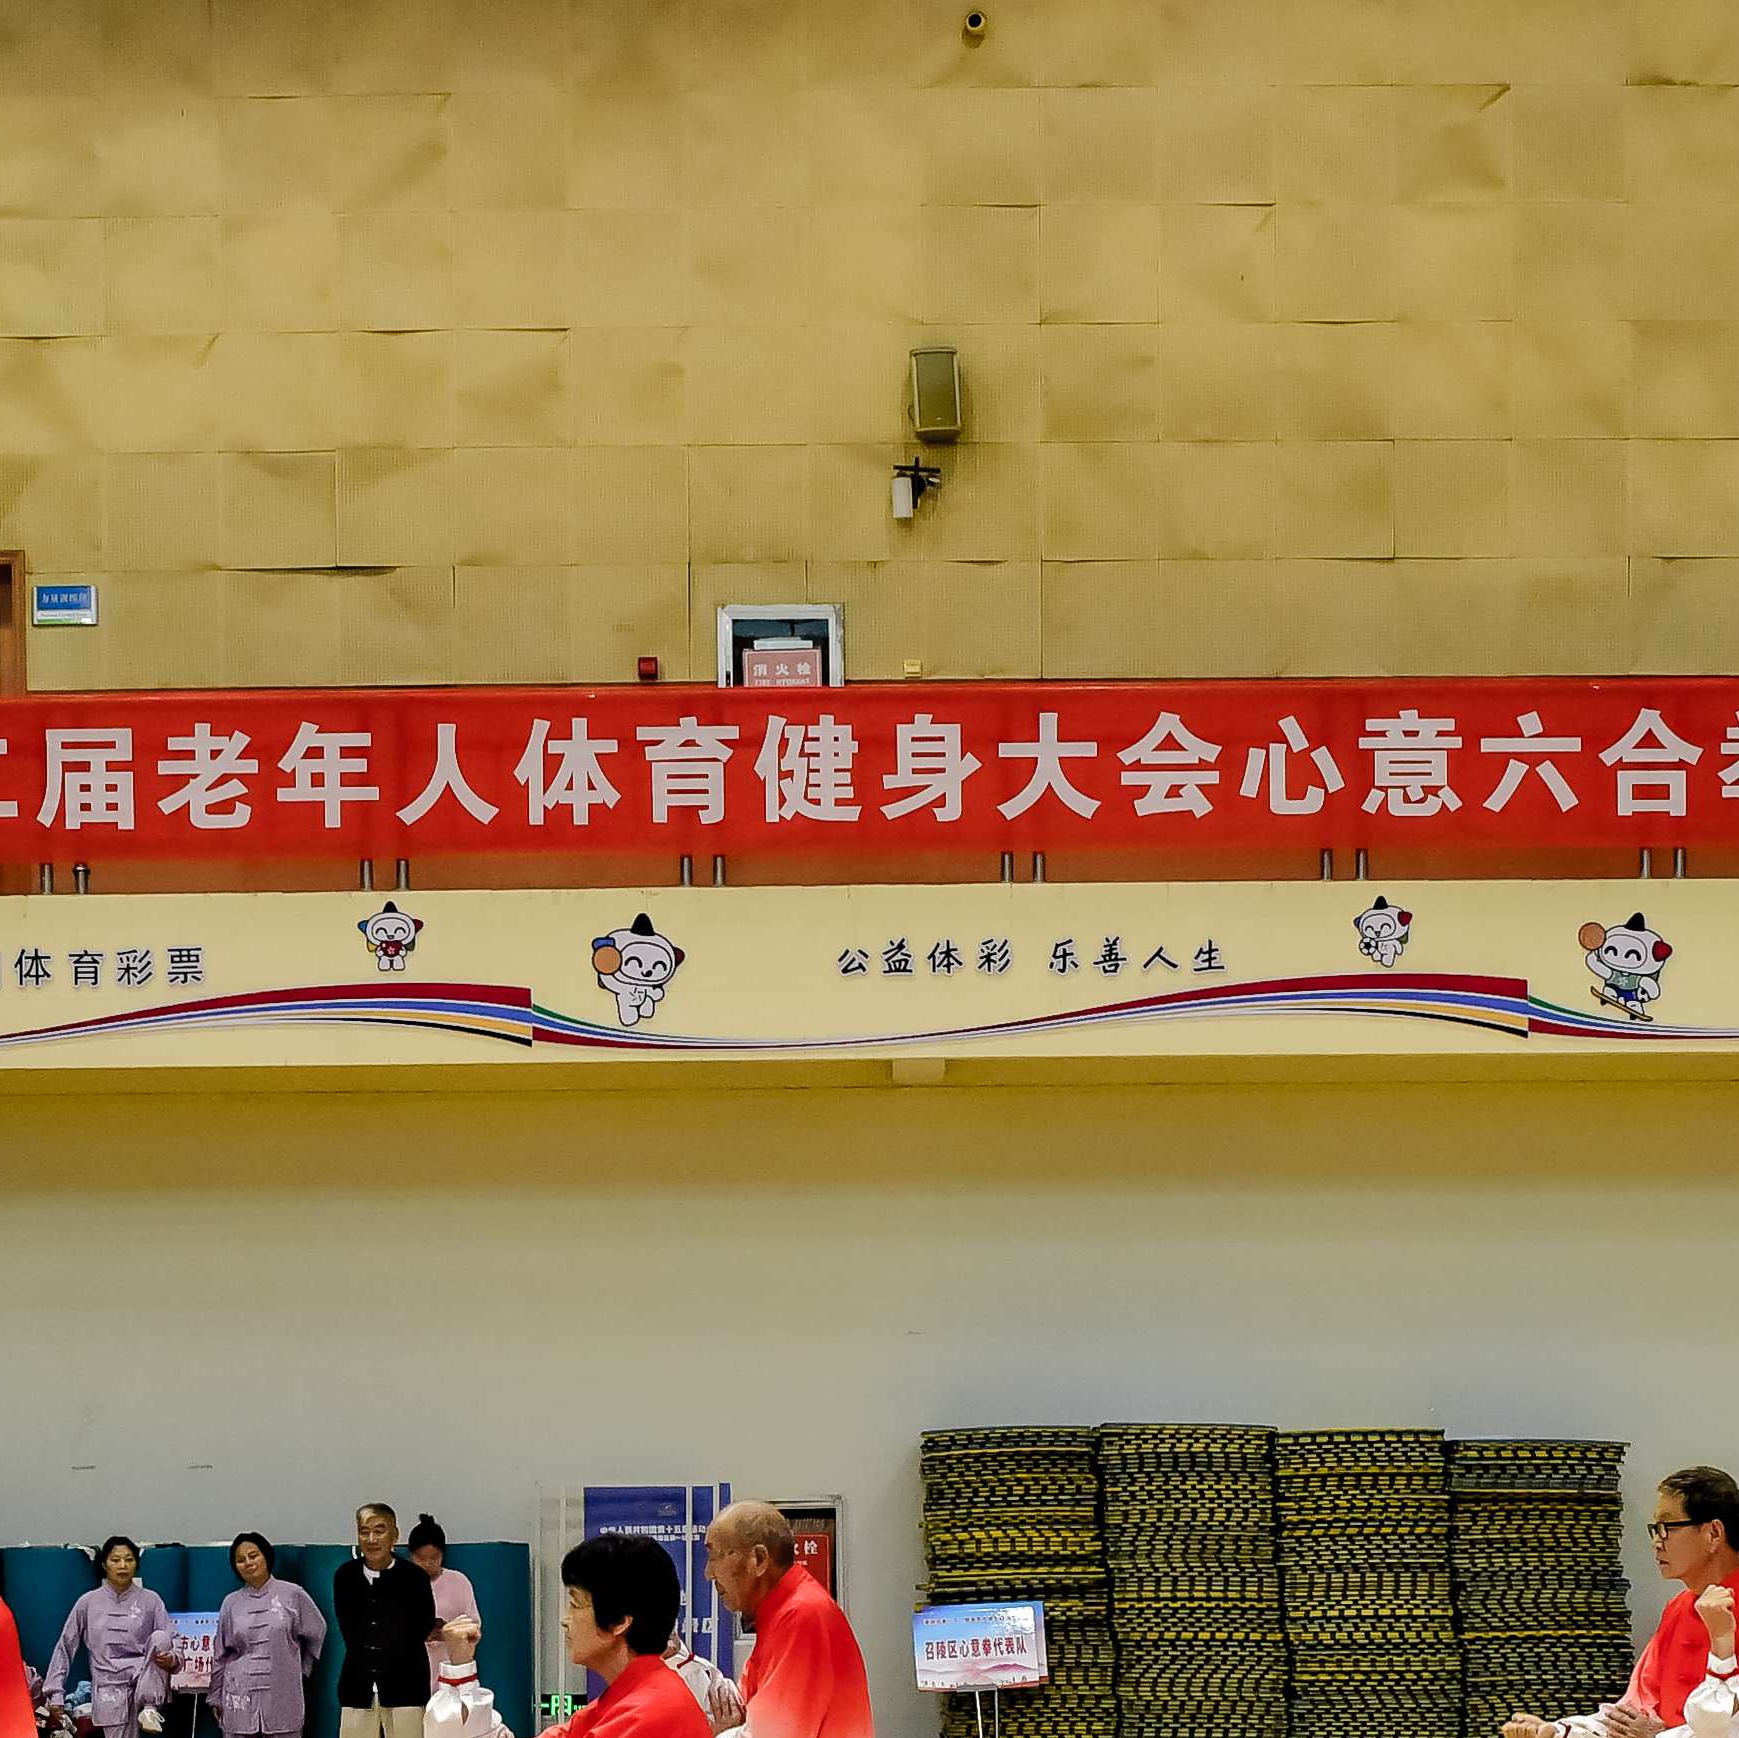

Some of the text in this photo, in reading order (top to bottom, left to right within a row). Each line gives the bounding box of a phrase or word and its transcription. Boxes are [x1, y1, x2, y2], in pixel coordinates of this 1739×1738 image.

[838, 936, 1228, 977] 公益体彩 乐善人生
[925, 1635, 1027, 1661] 召陵区心意拳代表队
